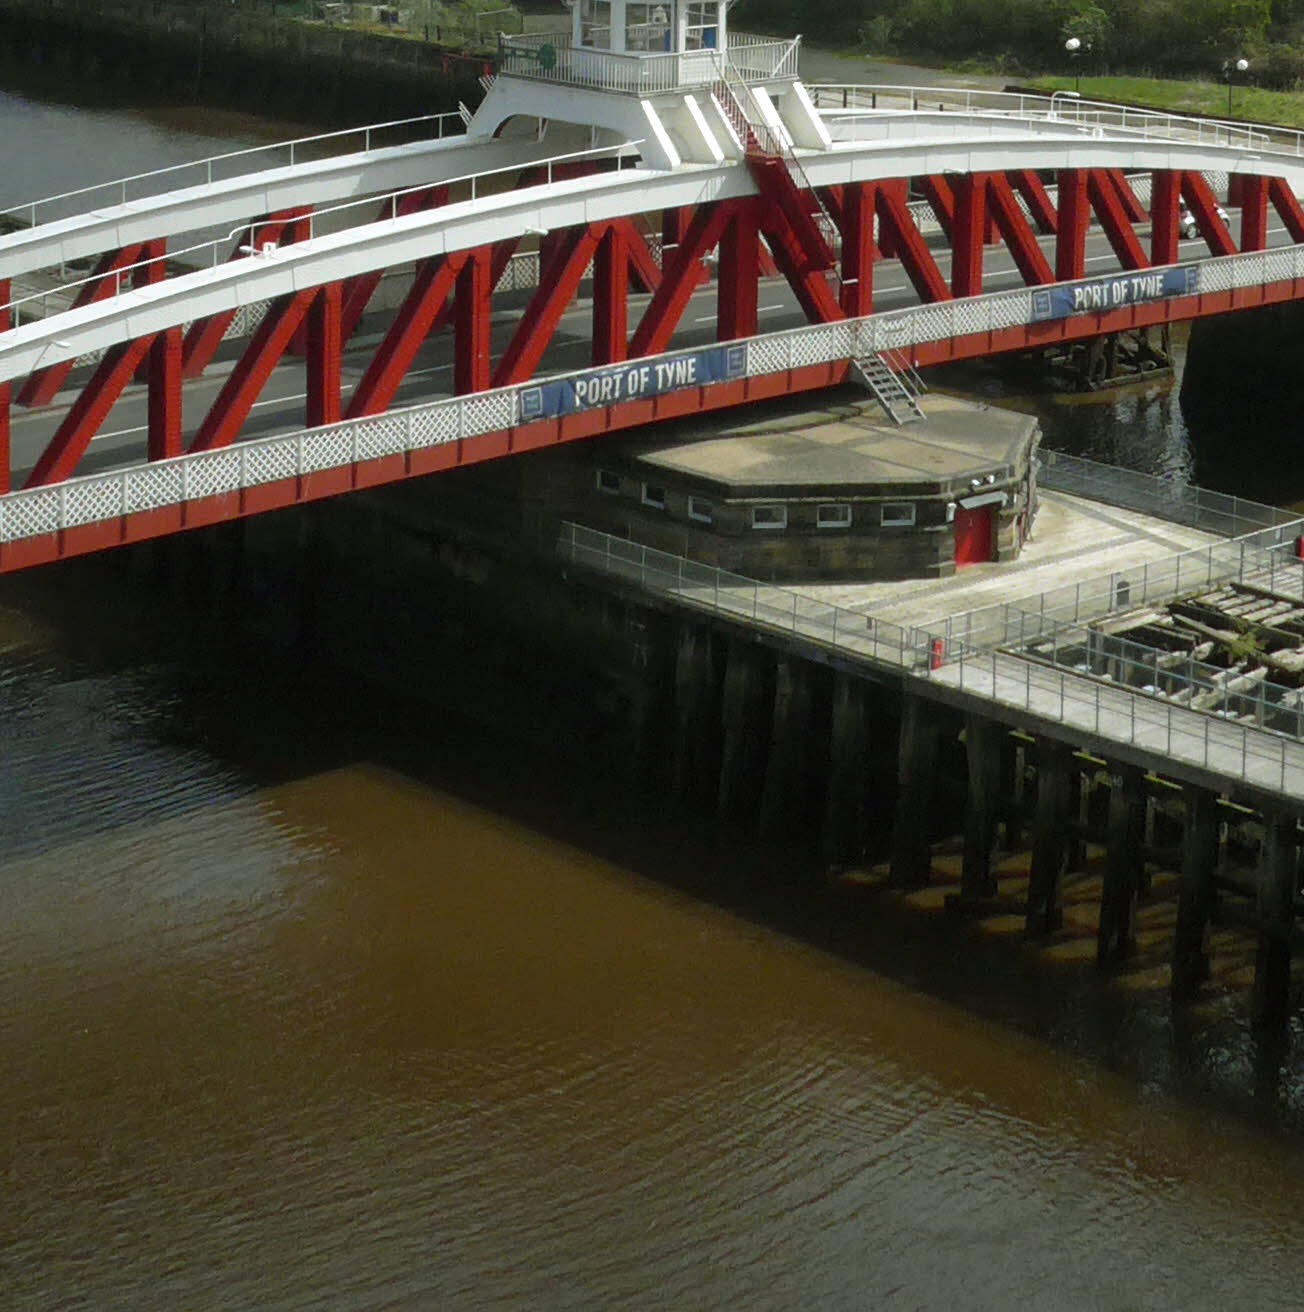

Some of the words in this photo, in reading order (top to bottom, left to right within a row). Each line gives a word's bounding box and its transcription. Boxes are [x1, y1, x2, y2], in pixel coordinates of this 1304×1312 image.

[1074, 285, 1110, 309] PORT
[1112, 280, 1128, 304] OF
[1132, 275, 1164, 299] TYNE
[575, 375, 622, 407] PORT
[627, 369, 652, 394] OF
[655, 358, 697, 390] TYNE
